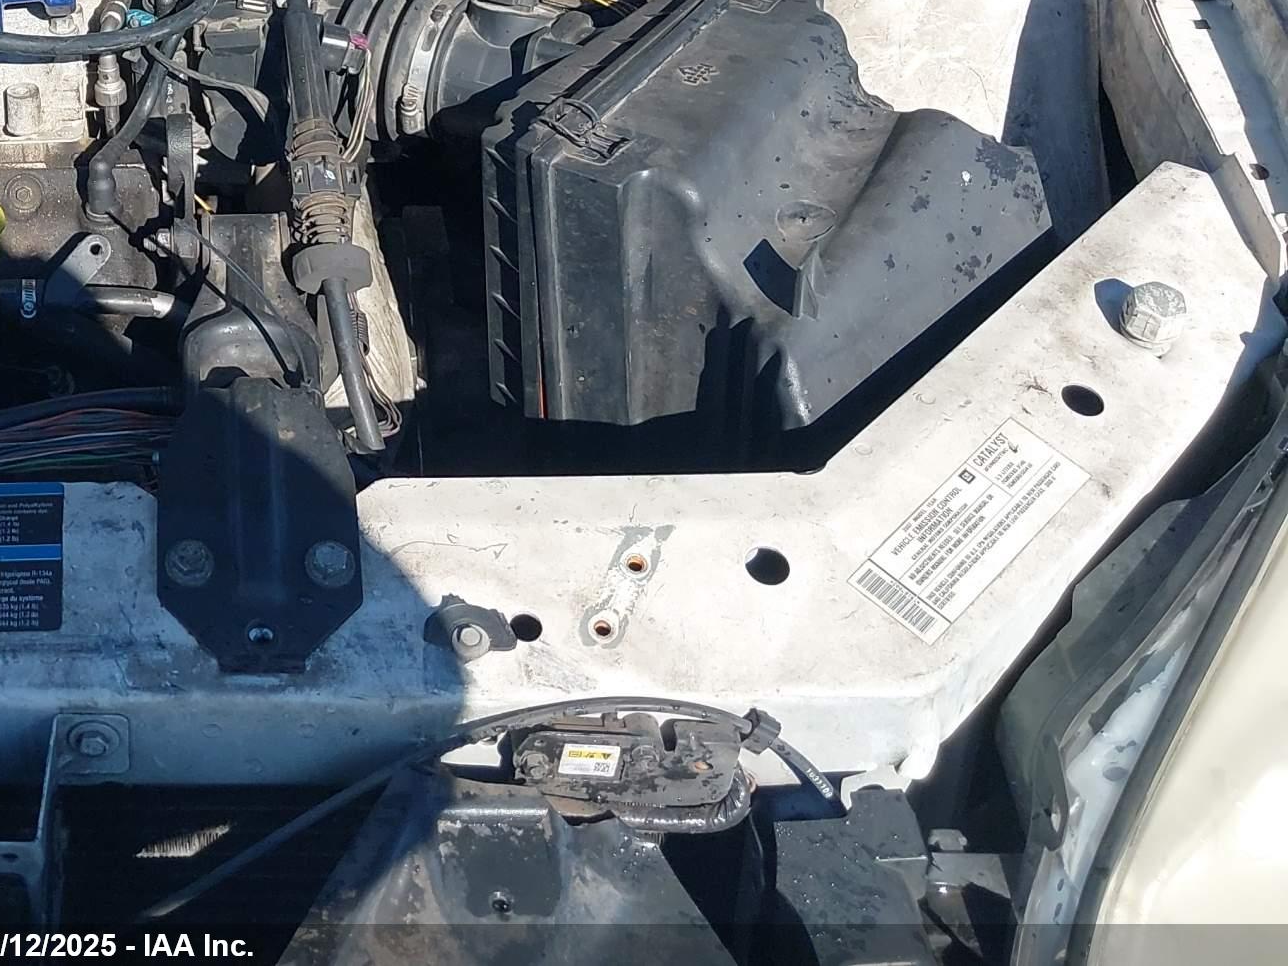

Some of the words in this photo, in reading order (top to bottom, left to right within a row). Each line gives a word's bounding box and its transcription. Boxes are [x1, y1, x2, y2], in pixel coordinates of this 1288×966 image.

[971, 431, 1009, 467] CATALYST
[890, 532, 915, 556] VEHICLE
[911, 507, 940, 534] EMISSION
[935, 485, 962, 511] CONTROL
[915, 506, 954, 543] INFORMATION
[910, 542, 929, 561] GENERAL
[926, 526, 944, 544] MOTORS
